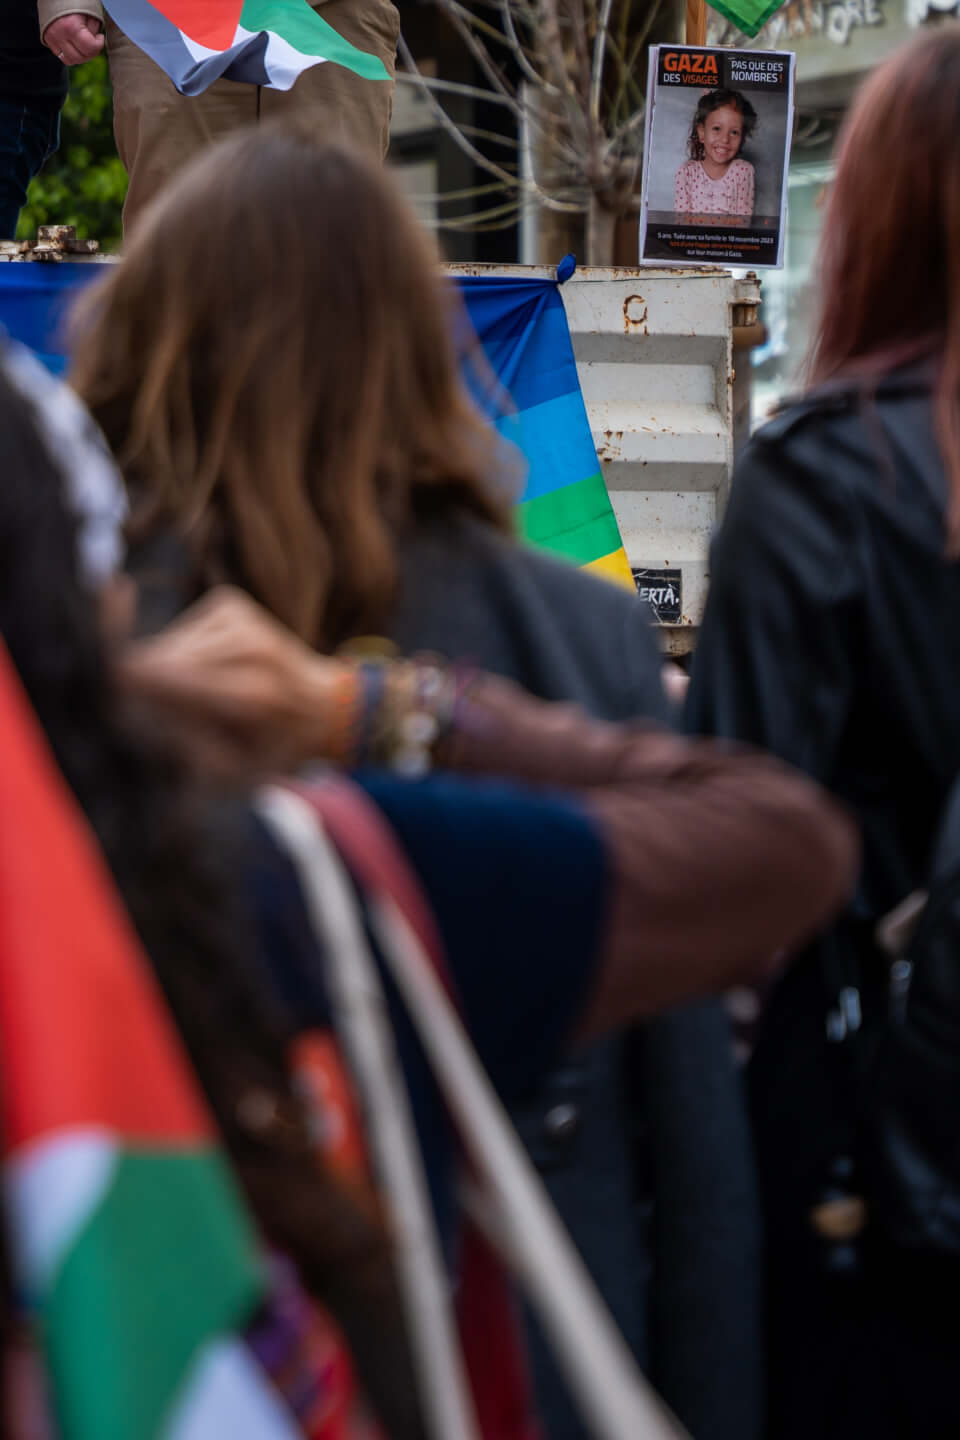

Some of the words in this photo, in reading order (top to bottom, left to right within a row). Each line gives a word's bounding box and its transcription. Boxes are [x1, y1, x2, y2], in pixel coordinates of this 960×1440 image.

[664, 52, 718, 74] GAZA
[731, 60, 748, 70] PAS
[748, 61, 766, 71] QUE
[767, 62, 784, 72] DES
[663, 73, 681, 83] DES
[682, 74, 719, 85] VISAGES
[731, 71, 778, 83] NOMBRES
